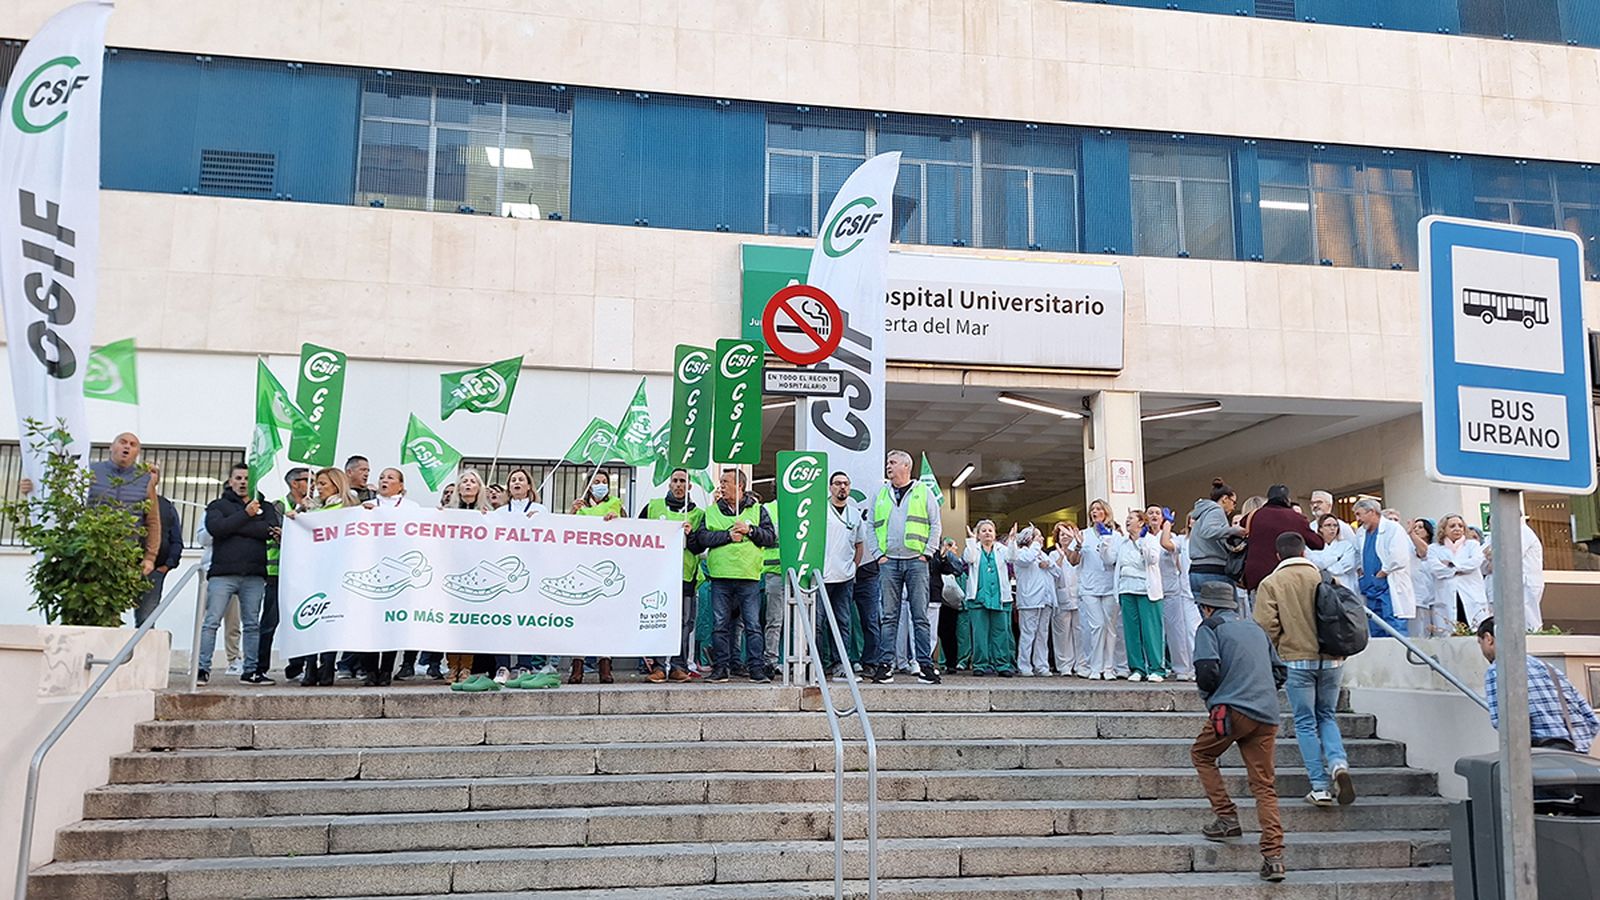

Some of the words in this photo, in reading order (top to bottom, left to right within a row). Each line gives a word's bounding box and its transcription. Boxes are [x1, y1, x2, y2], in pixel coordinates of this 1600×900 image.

[836, 212, 883, 238] CSIF
[18, 188, 77, 379] CSIF
[885, 286, 953, 311] spital
[960, 290, 1105, 316] Universitario
[885, 317, 917, 333] erta
[923, 317, 951, 335] del
[956, 319, 989, 336] Mar
[728, 382, 748, 459] CSIF
[1491, 399, 1535, 422] BUS
[682, 388, 701, 464] CSIF
[1468, 421, 1560, 449] URBANO
[312, 526, 339, 543] EN
[345, 522, 397, 537] ESTE
[403, 522, 488, 540] CENTRO
[494, 527, 557, 543] FALTA
[563, 530, 665, 549] PERSONAL
[384, 610, 408, 623] NO
[413, 609, 444, 624] MÁS
[448, 612, 512, 626] ZUECOS
[517, 612, 575, 628] VACÍOS
